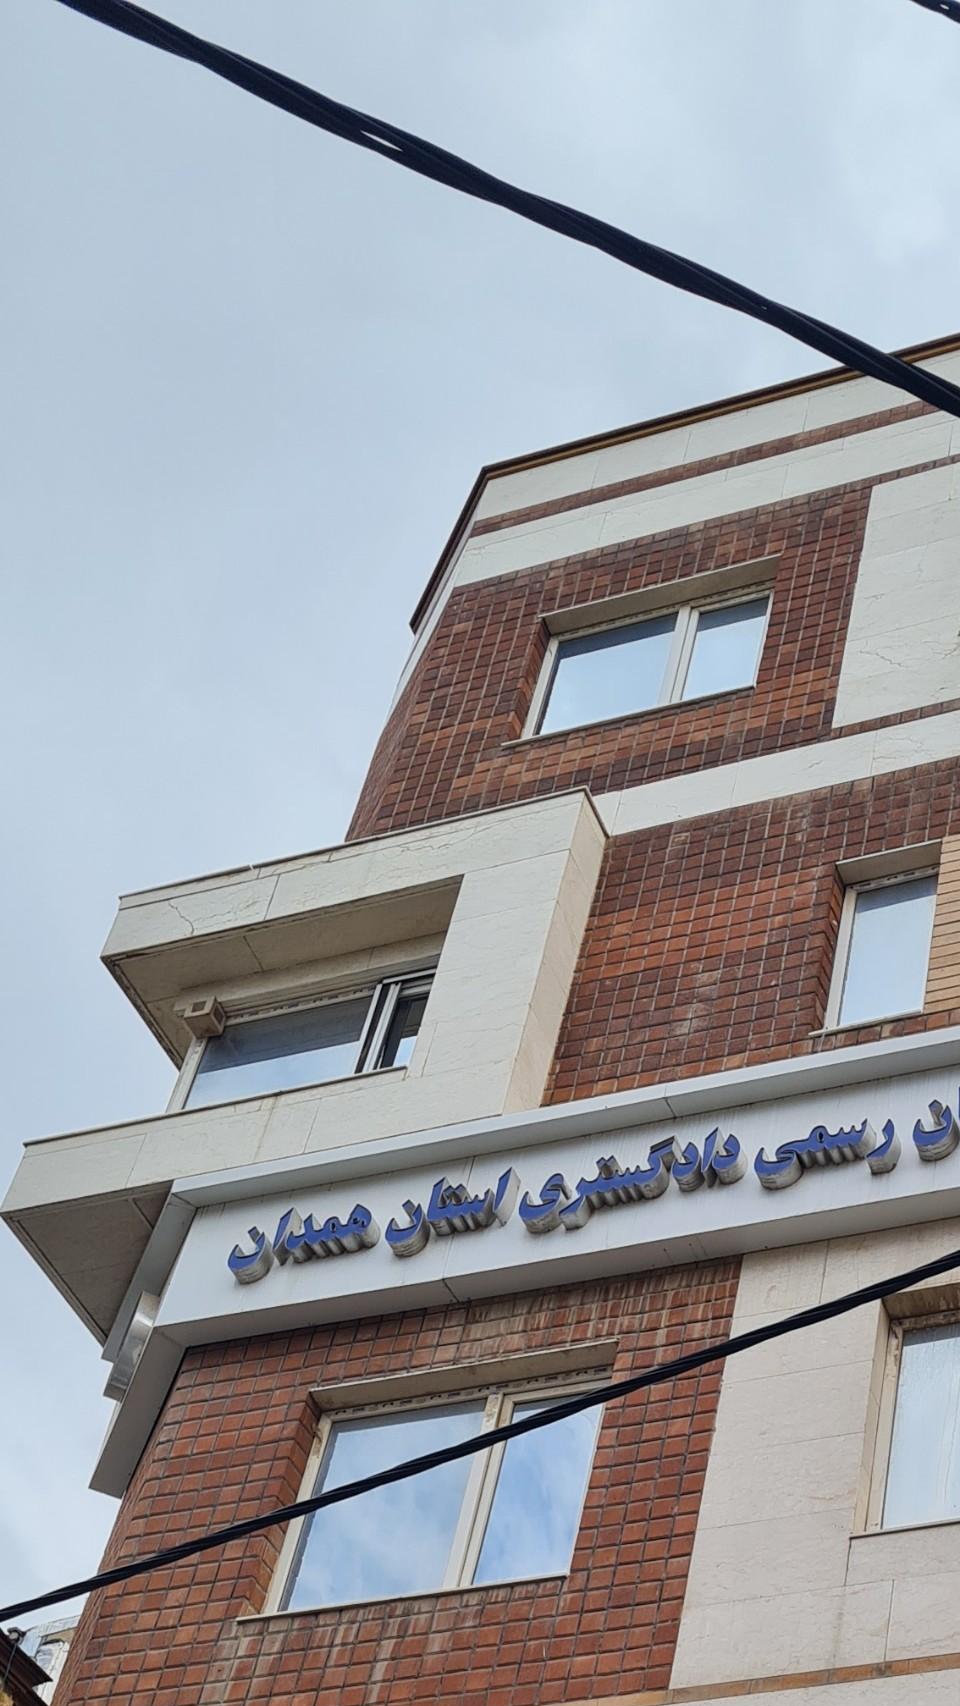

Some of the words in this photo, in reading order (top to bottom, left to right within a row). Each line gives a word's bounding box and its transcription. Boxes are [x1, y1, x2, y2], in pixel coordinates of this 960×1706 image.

[519, 1127, 742, 1226] دادگستری
[755, 1116, 895, 1182] رسمی
[228, 1203, 376, 1279] همدان
[386, 1167, 516, 1250] استان
